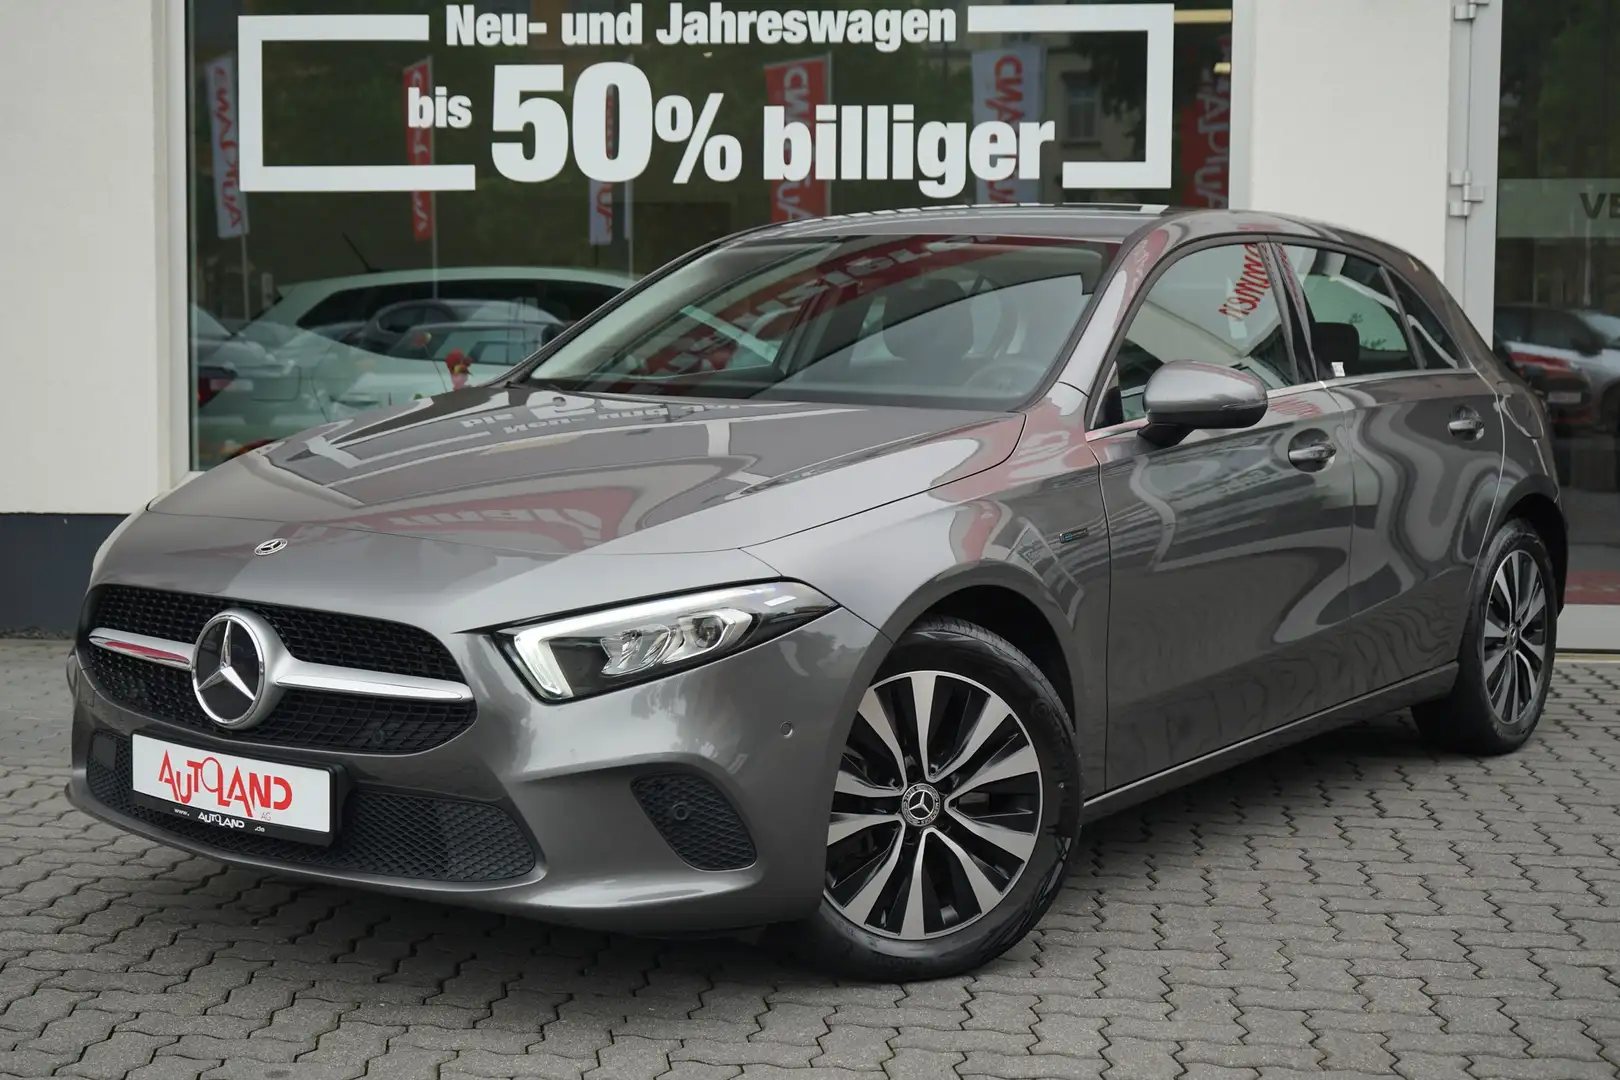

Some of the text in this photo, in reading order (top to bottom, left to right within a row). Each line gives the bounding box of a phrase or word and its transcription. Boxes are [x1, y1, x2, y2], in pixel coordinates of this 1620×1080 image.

[447, 2, 957, 52] Neu- und Jahreswagen
[408, 86, 472, 129] bis
[491, 61, 743, 184] 50%
[763, 104, 1056, 199] billiger
[158, 748, 293, 818] AUTOLAND
[198, 812, 246, 829] AUTOLAND
